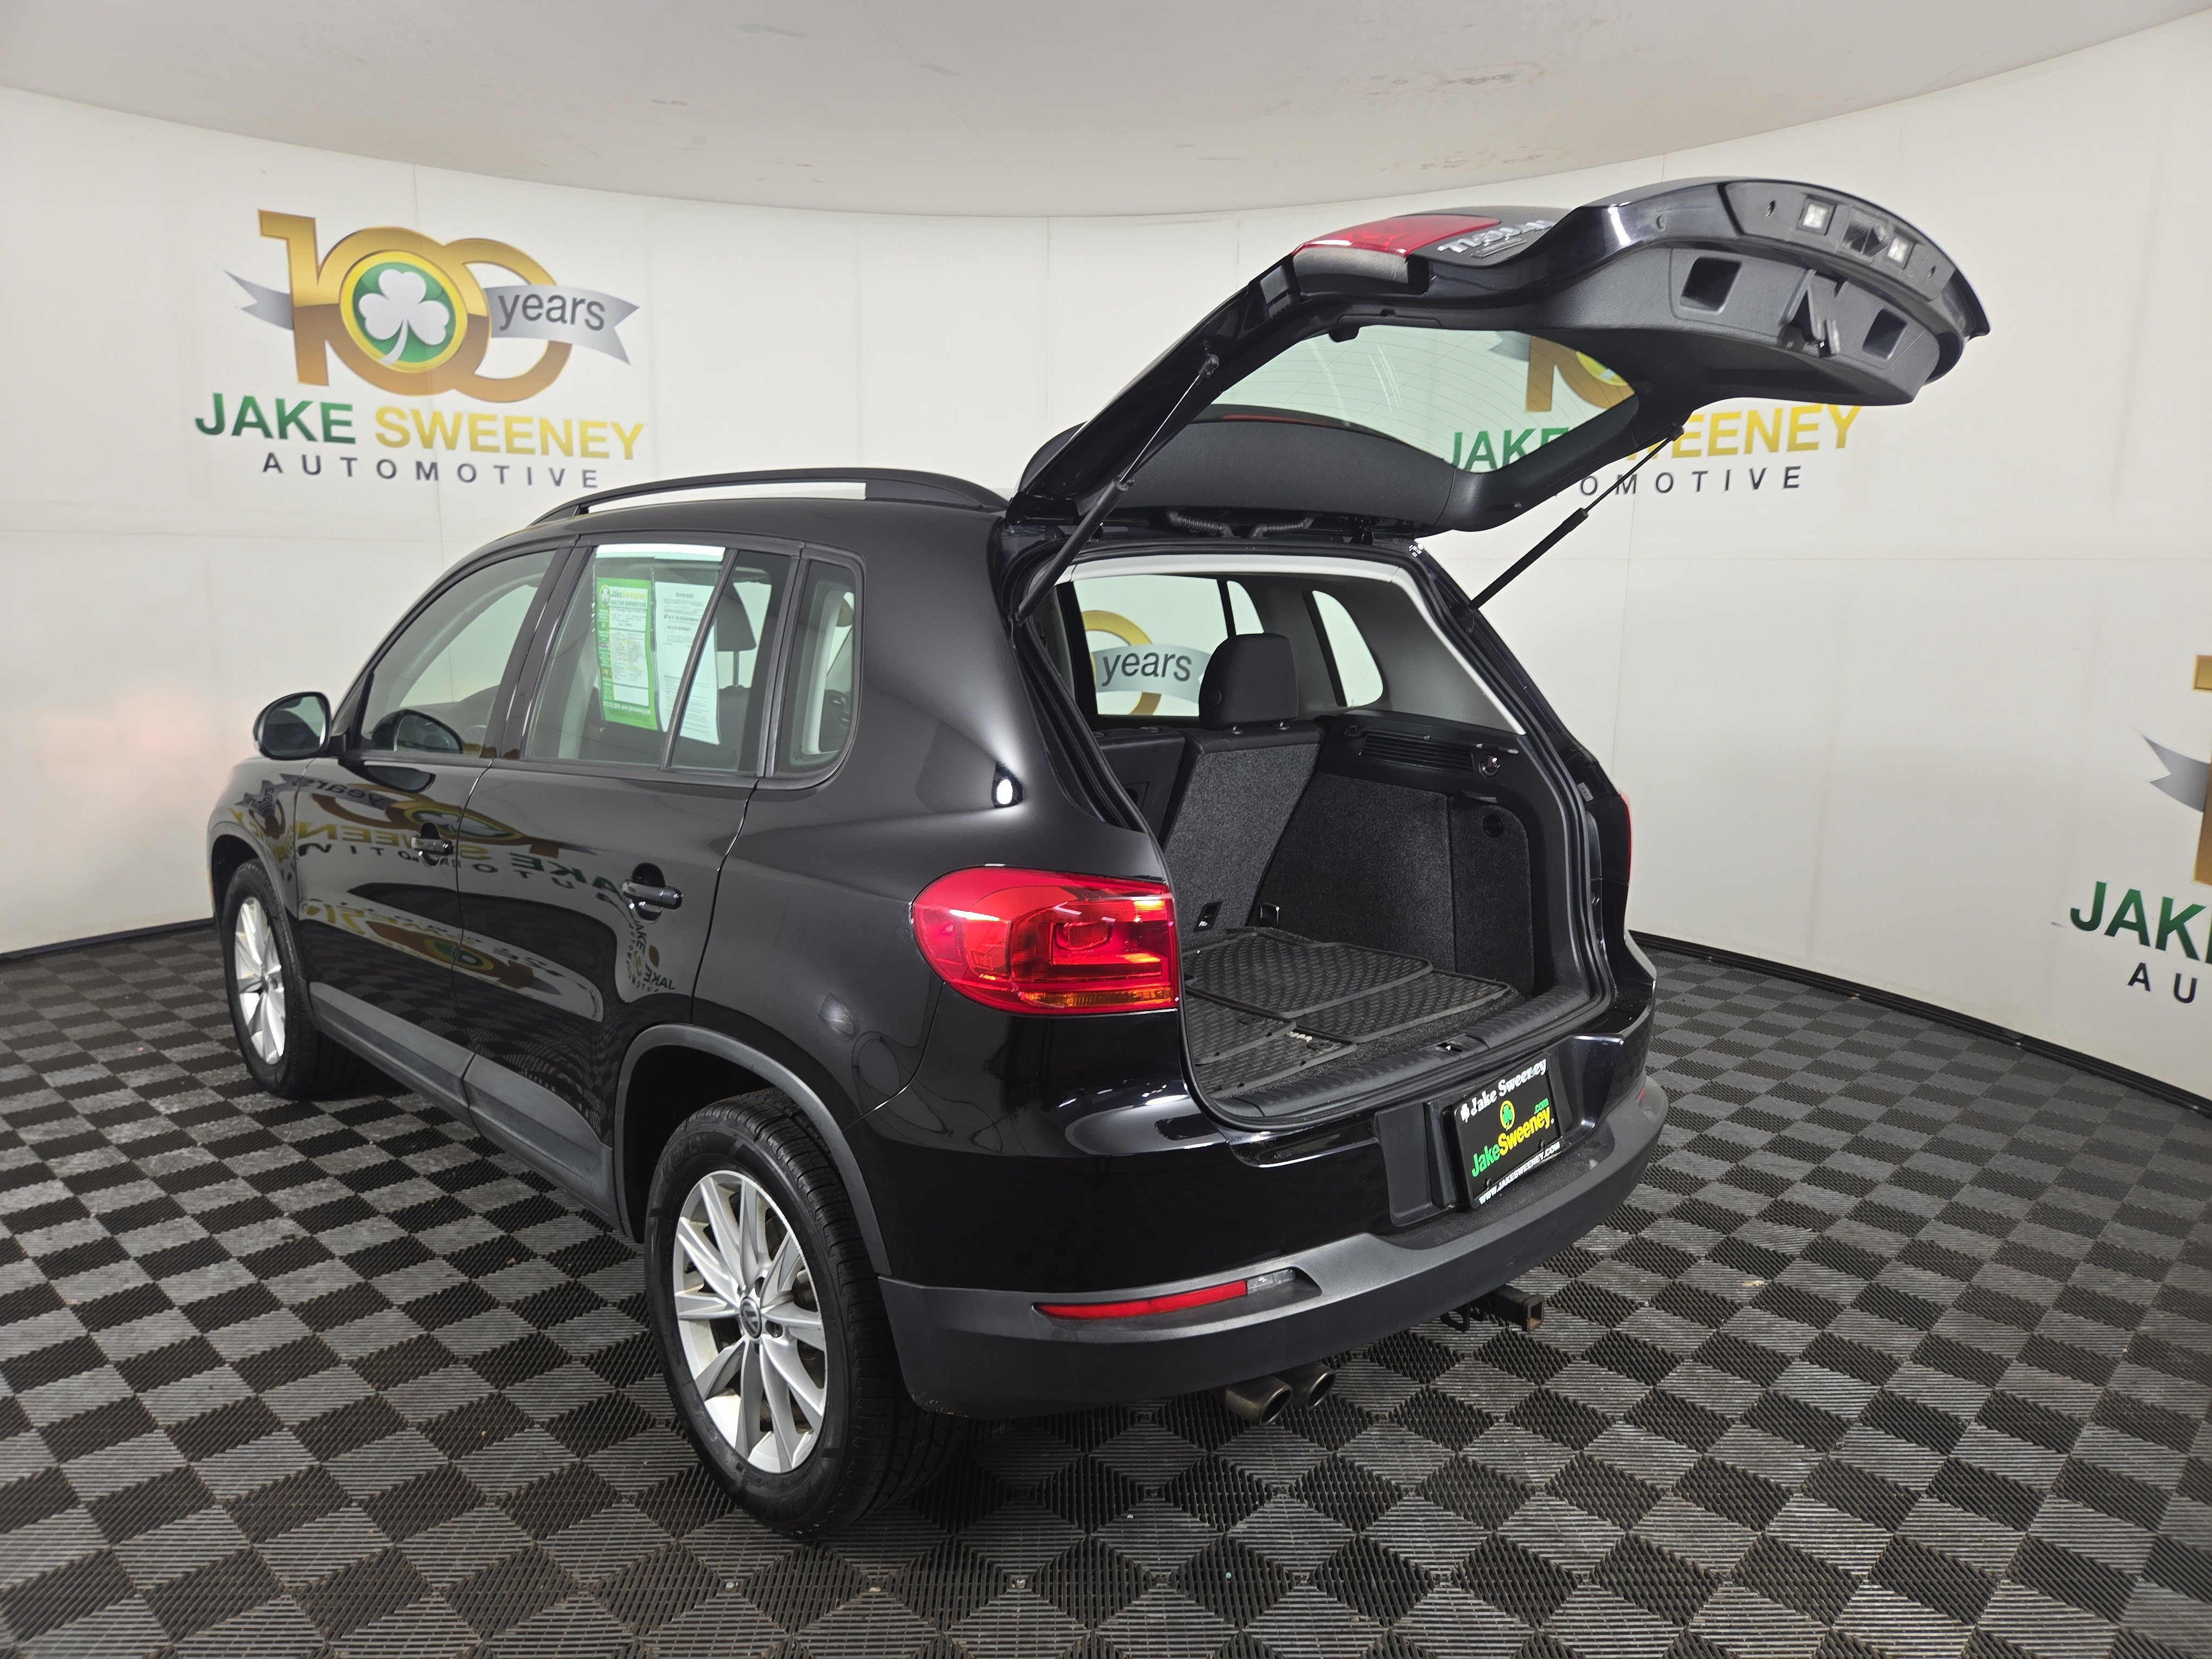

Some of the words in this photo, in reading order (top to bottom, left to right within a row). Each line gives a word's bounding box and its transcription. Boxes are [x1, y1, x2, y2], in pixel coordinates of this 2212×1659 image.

[497, 291, 606, 332] years
[195, 391, 357, 445] JAKE
[375, 406, 645, 460] SWEENEY
[1626, 403, 1863, 461] EENEY
[262, 452, 598, 489] AUTOMOTIVE
[1580, 465, 1802, 497] OMOTIVE
[1102, 651, 1192, 687] years
[2069, 879, 2212, 967] JAK
[1470, 1090, 1497, 1116] Jake
